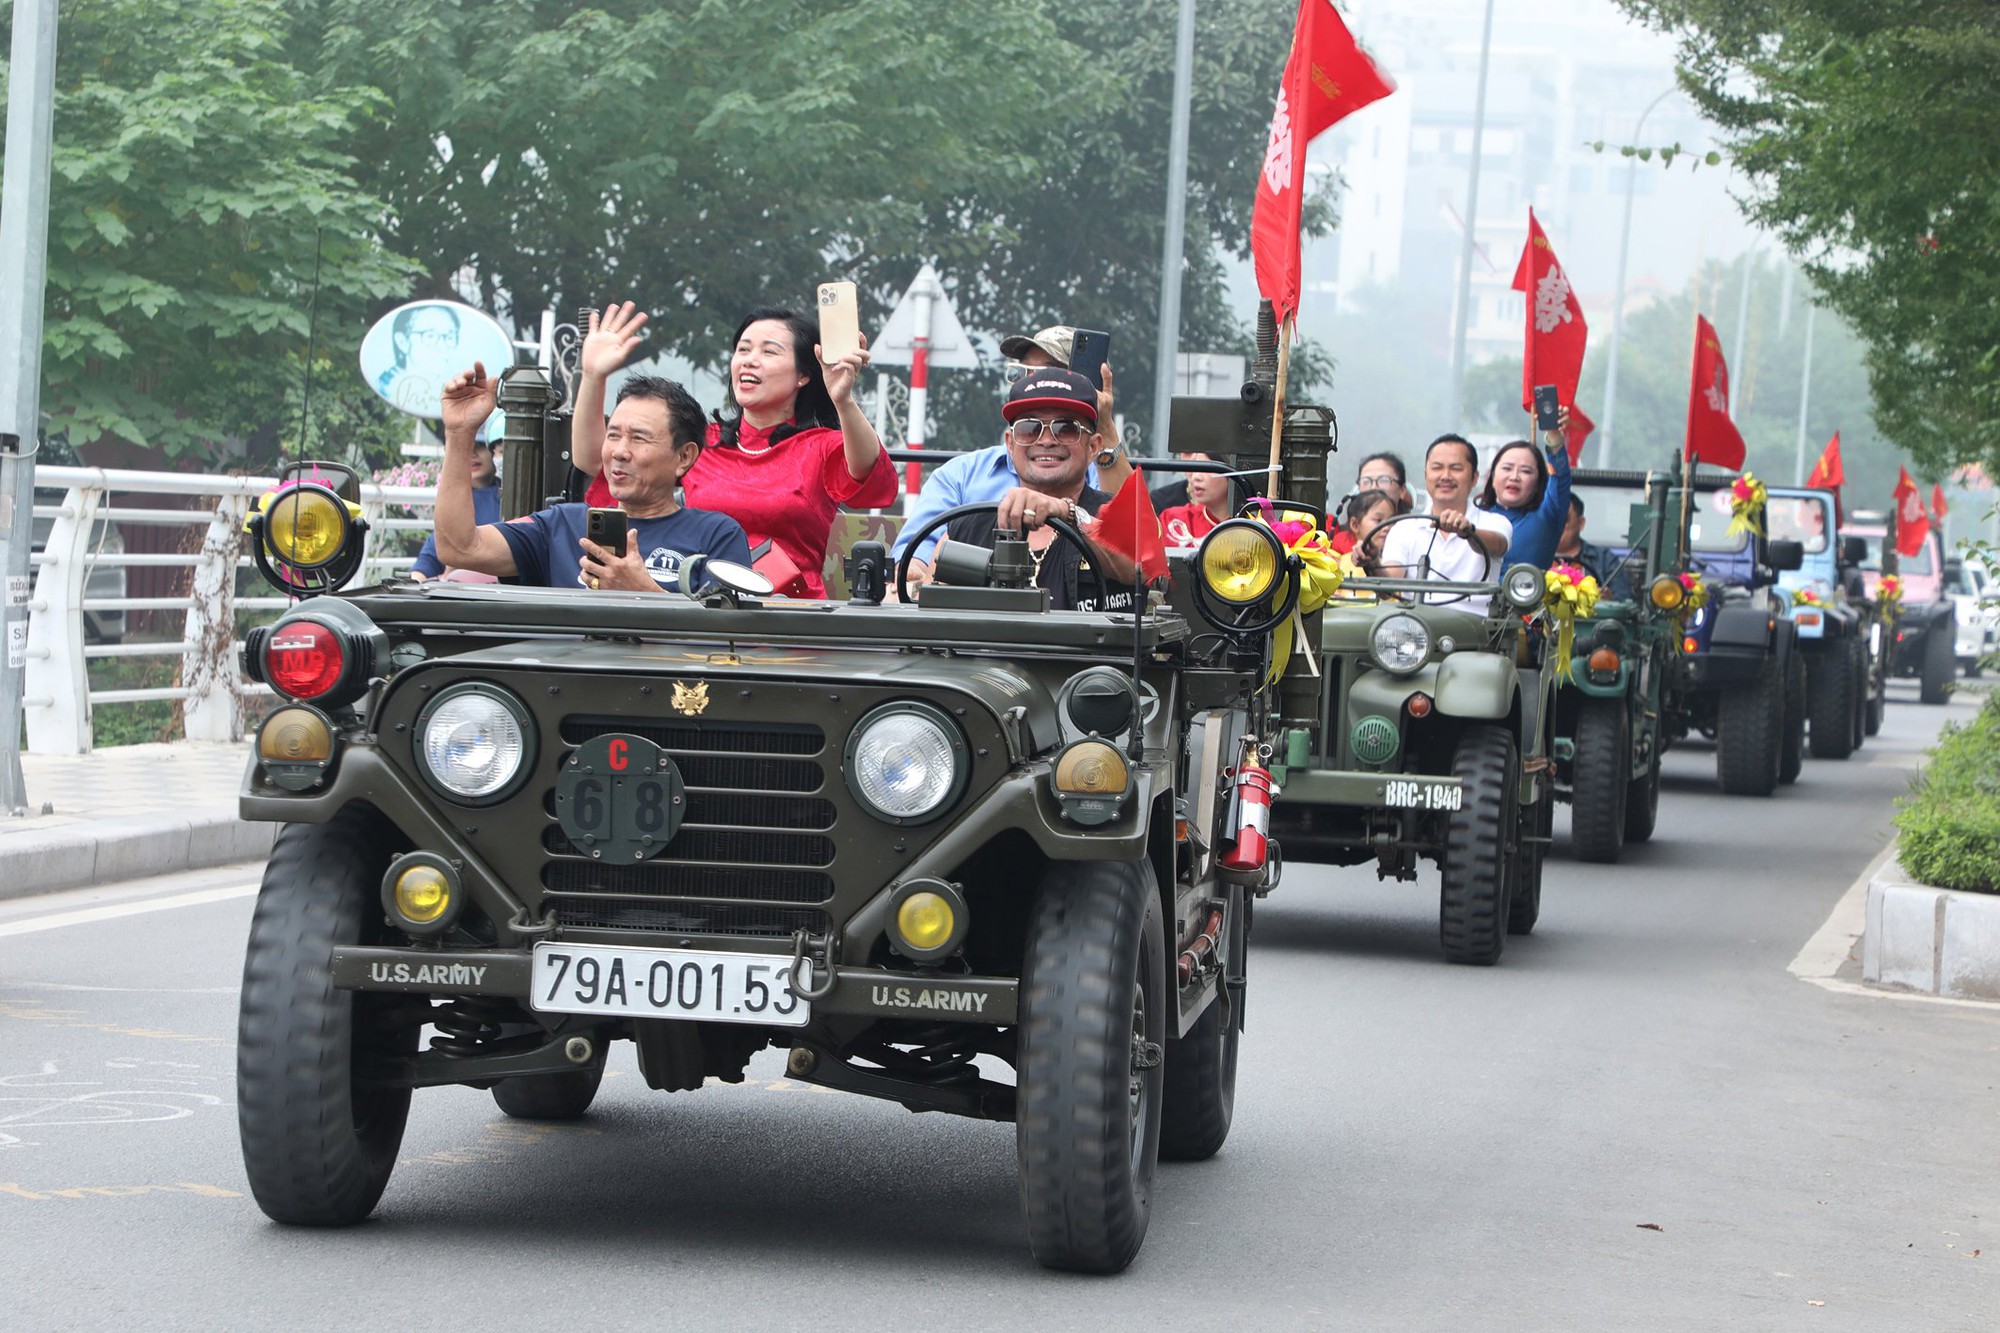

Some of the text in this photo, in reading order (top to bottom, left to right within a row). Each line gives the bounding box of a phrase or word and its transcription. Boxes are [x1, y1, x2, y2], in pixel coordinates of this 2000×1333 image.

[1036, 380, 1073, 392] Kappa
[661, 556, 674, 569] 11
[609, 739, 628, 770] C
[1385, 780, 1463, 811] BRC-1940
[546, 953, 798, 1016] 79A-001.53
